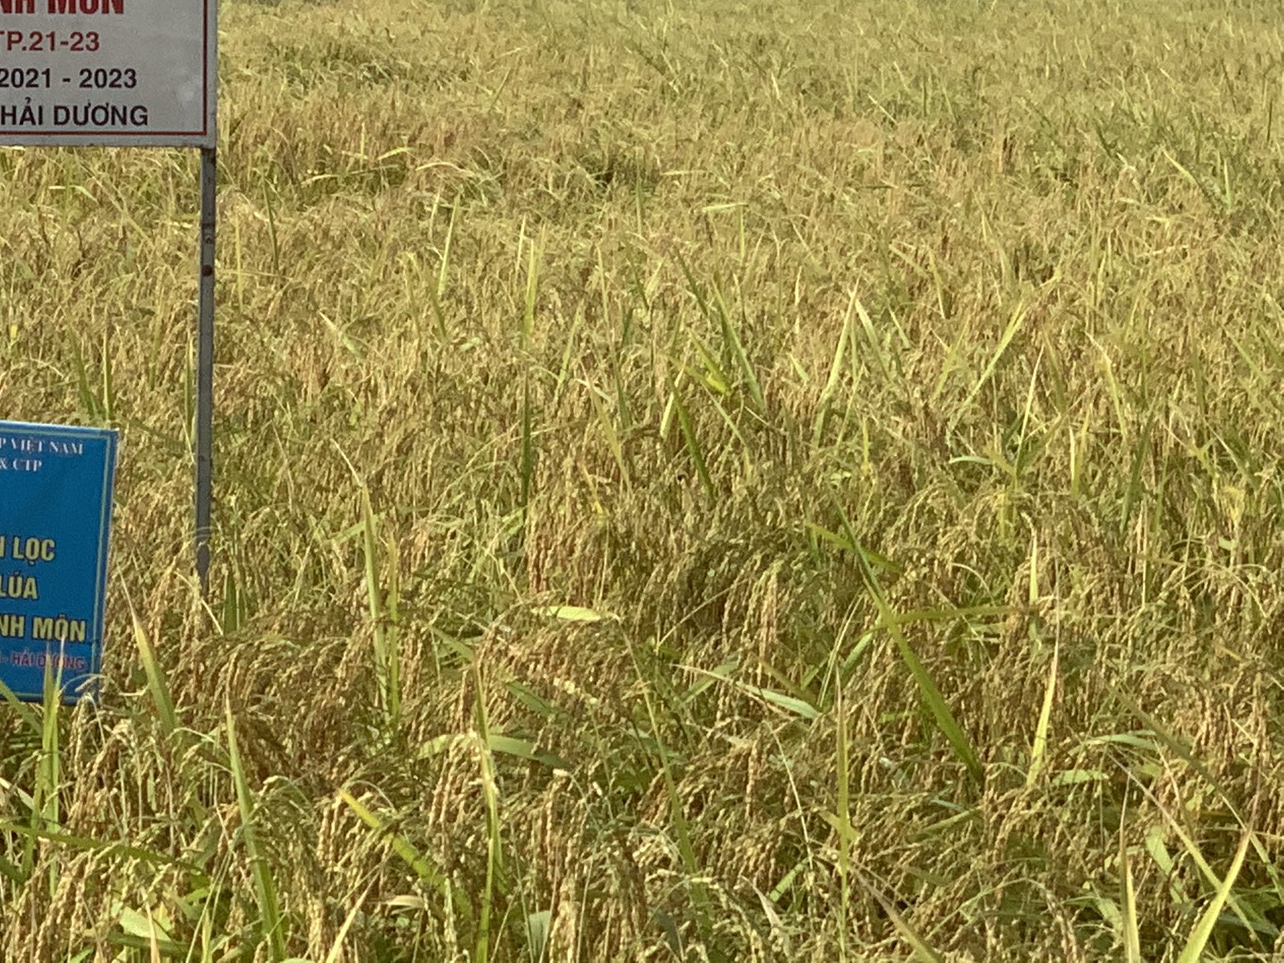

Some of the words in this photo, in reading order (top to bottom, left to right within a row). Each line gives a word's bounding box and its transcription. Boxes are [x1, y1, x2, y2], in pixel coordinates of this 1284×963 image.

[79, 68, 137, 88] 2023
[1, 97, 43, 125] HẢI
[54, 102, 148, 126] DƯƠNG
[11, 437, 44, 454] VIỆT
[50, 441, 83, 455] NAM
[13, 459, 42, 471] CTP
[13, 536, 55, 565] LỌC
[34, 614, 85, 642] MÔN
